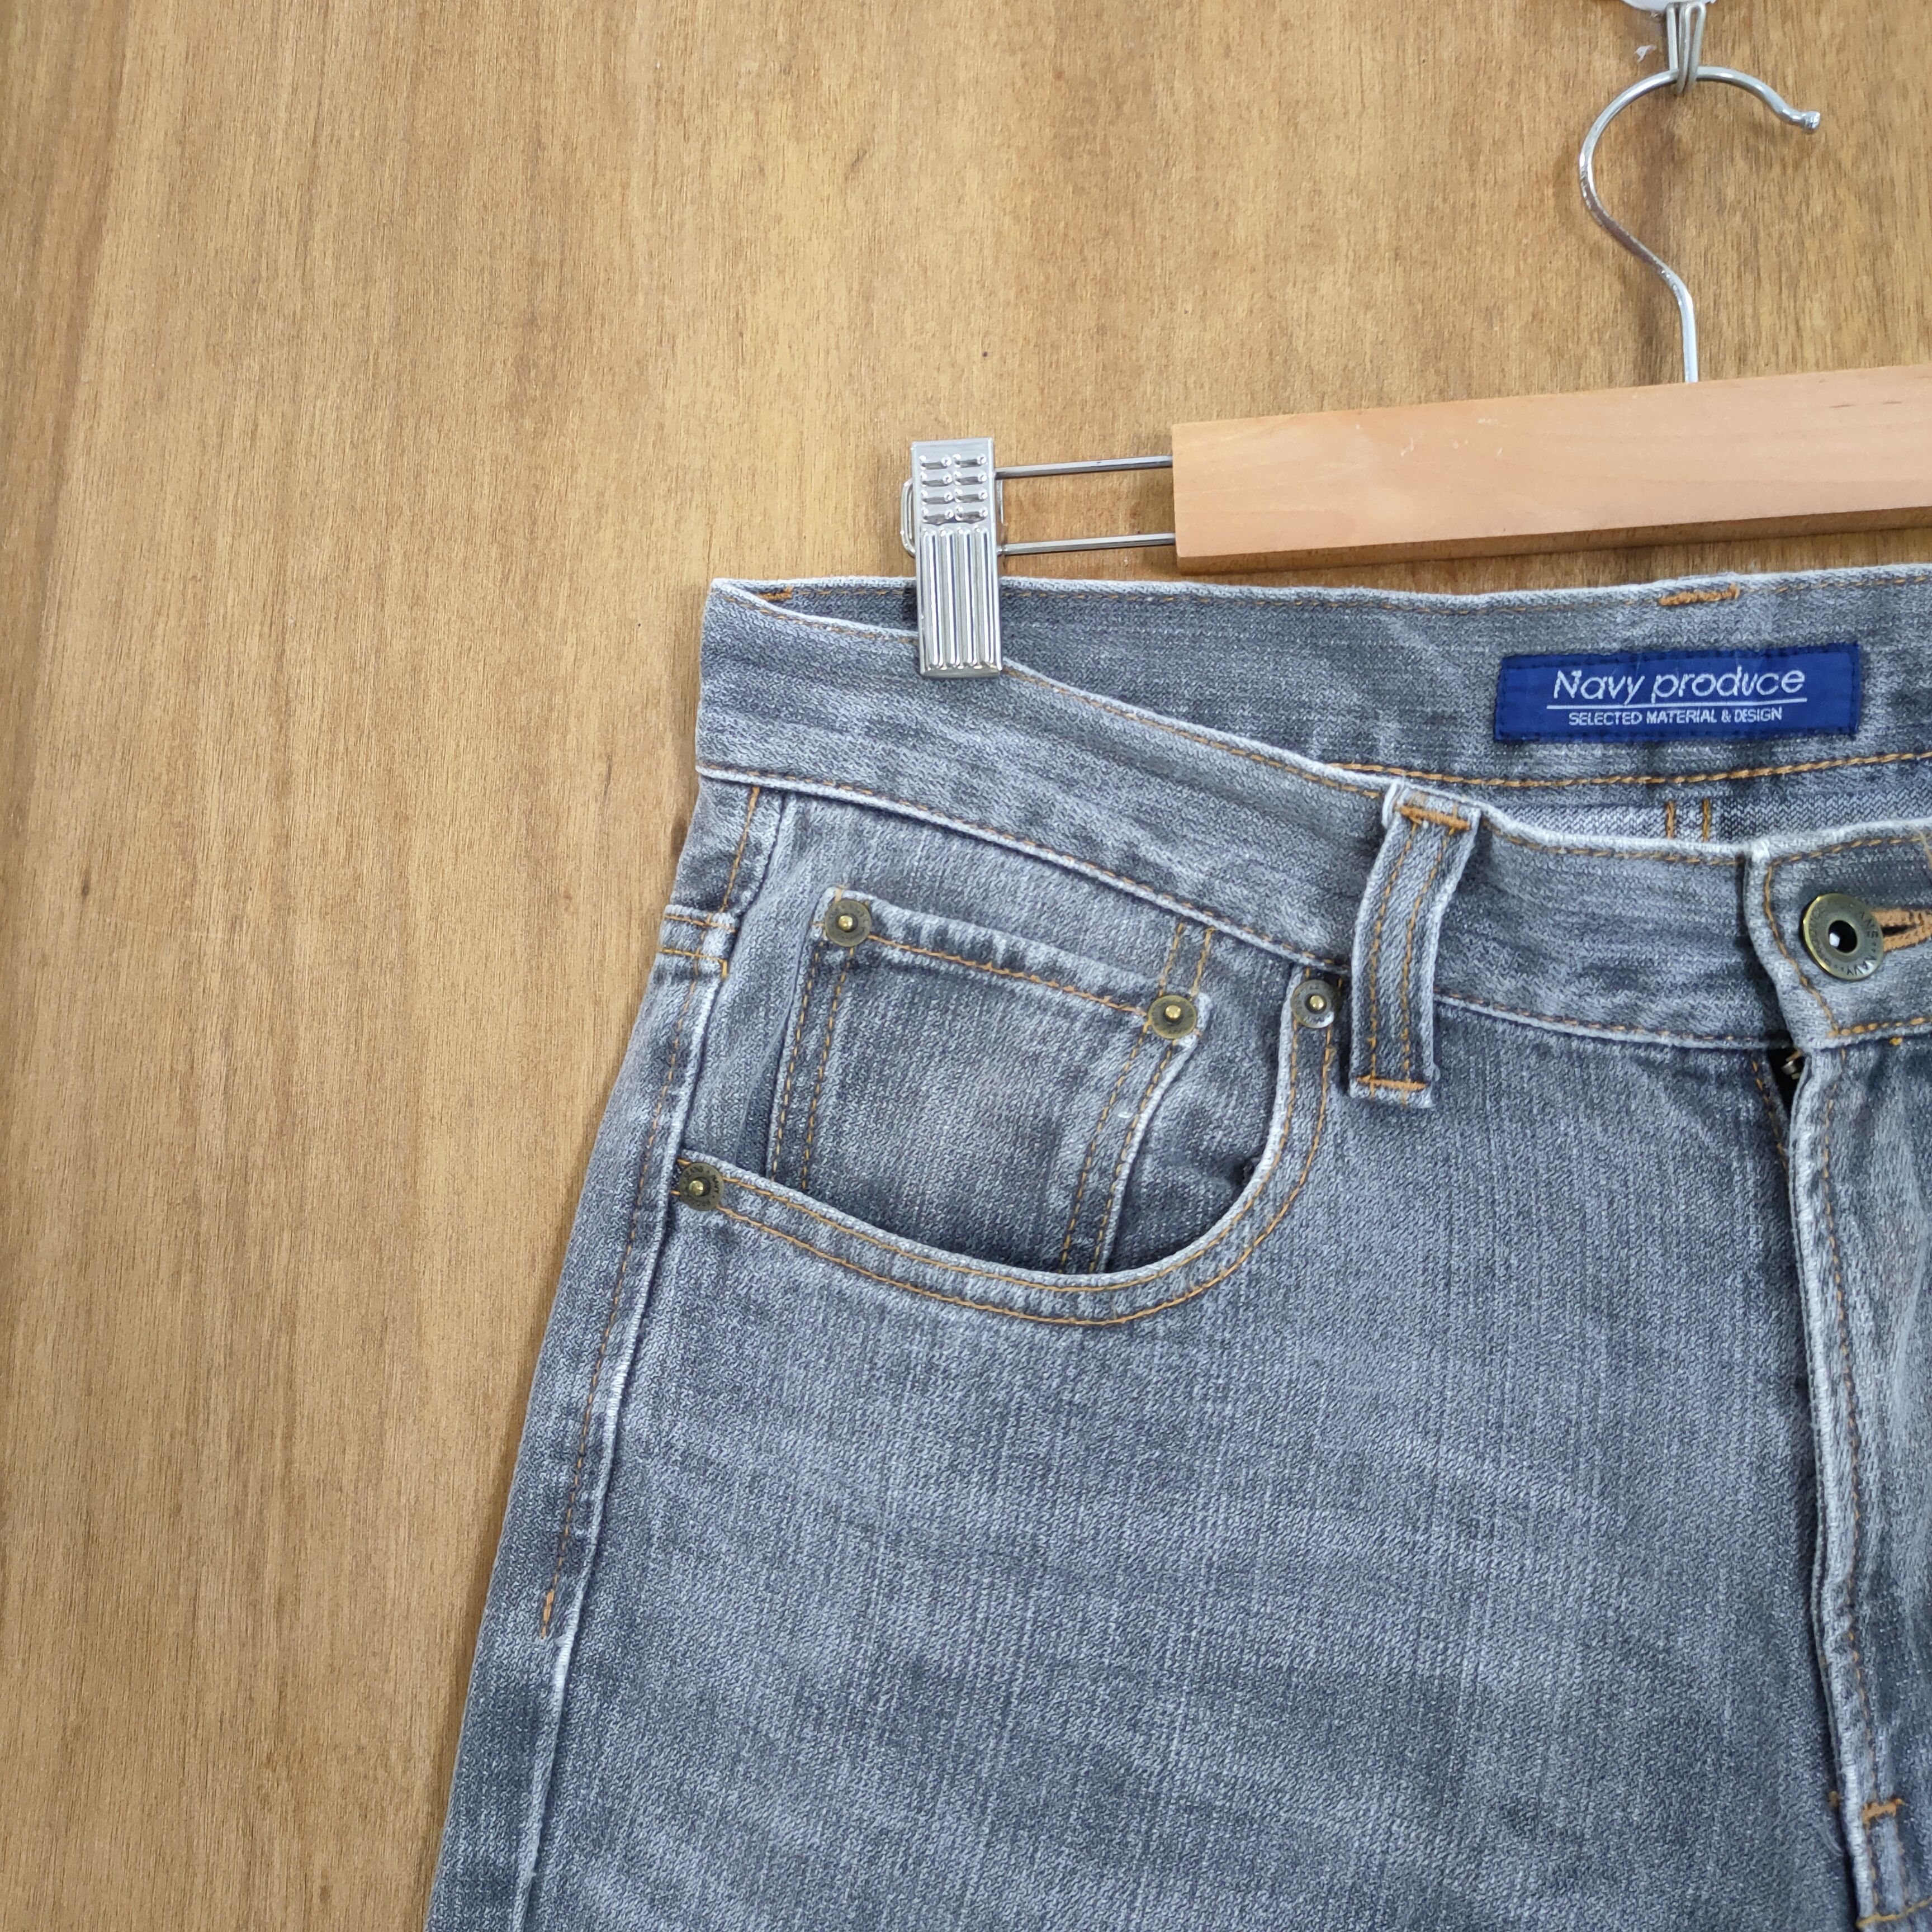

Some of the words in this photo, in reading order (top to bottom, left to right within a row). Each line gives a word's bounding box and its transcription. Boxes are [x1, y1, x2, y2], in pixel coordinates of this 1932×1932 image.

[1554, 670, 1645, 704] Navy
[1651, 665, 1805, 703] produce
[1569, 711, 1642, 726] SELECTED
[1646, 709, 1717, 724] MATERIAL
[1721, 709, 1731, 723] &
[1734, 707, 1782, 723] DESIGN
